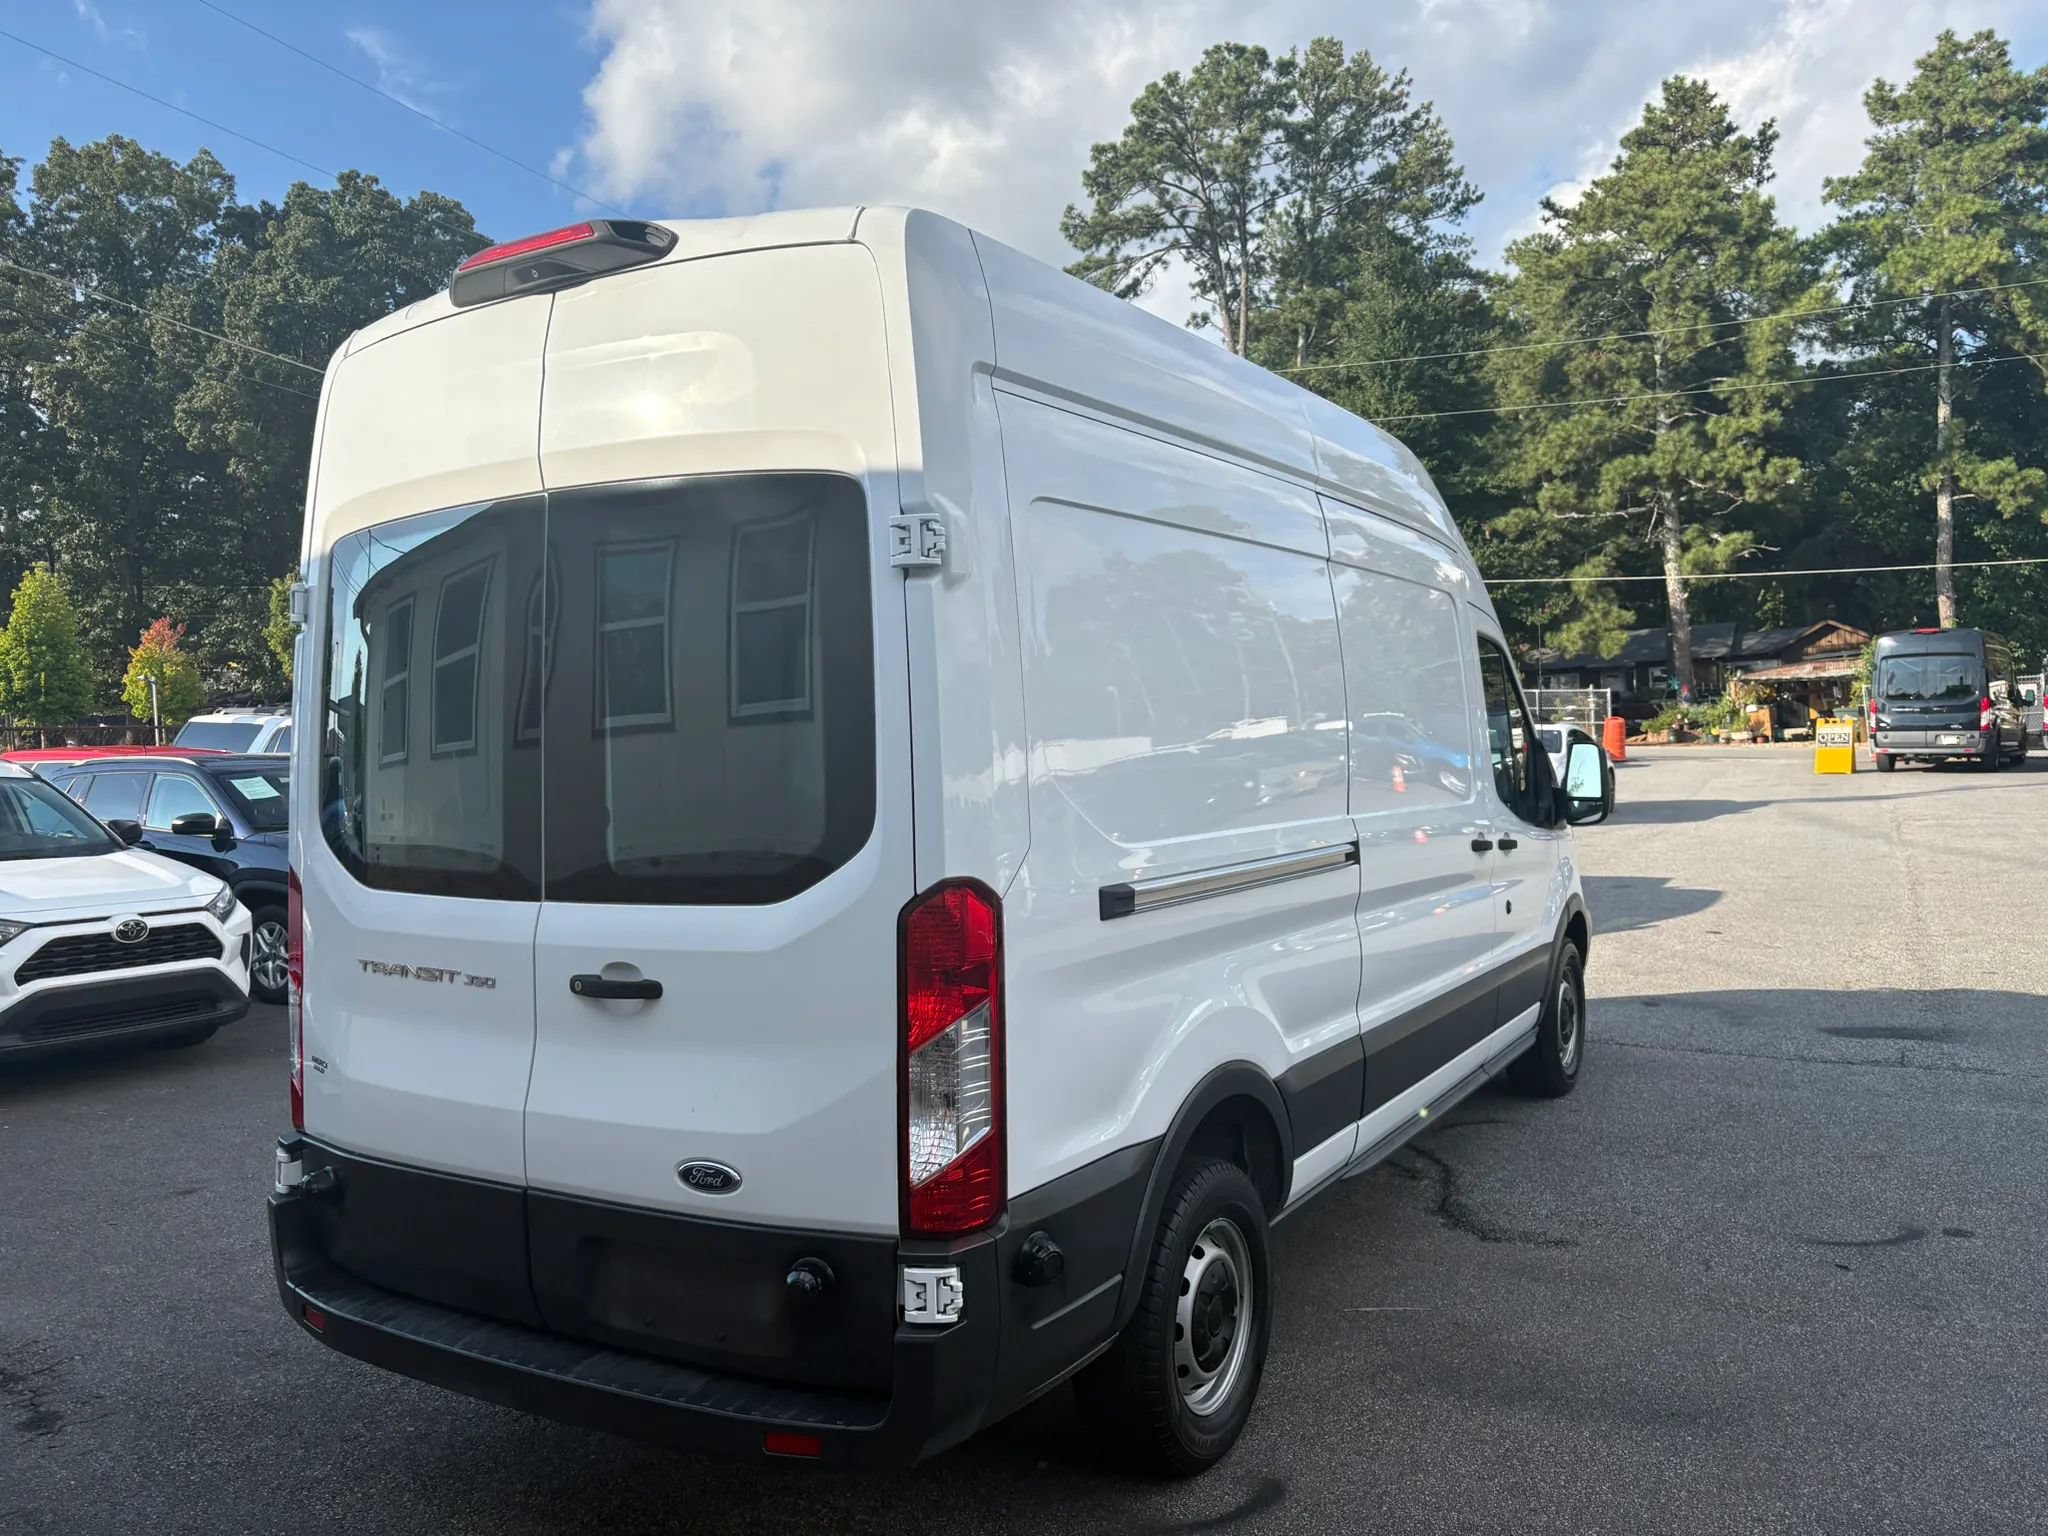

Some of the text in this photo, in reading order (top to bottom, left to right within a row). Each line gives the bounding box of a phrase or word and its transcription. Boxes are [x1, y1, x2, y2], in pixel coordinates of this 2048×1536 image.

[1818, 732, 1849, 743] OPEN
[357, 958, 461, 985] TRANSIT
[689, 1166, 725, 1187] Ford
